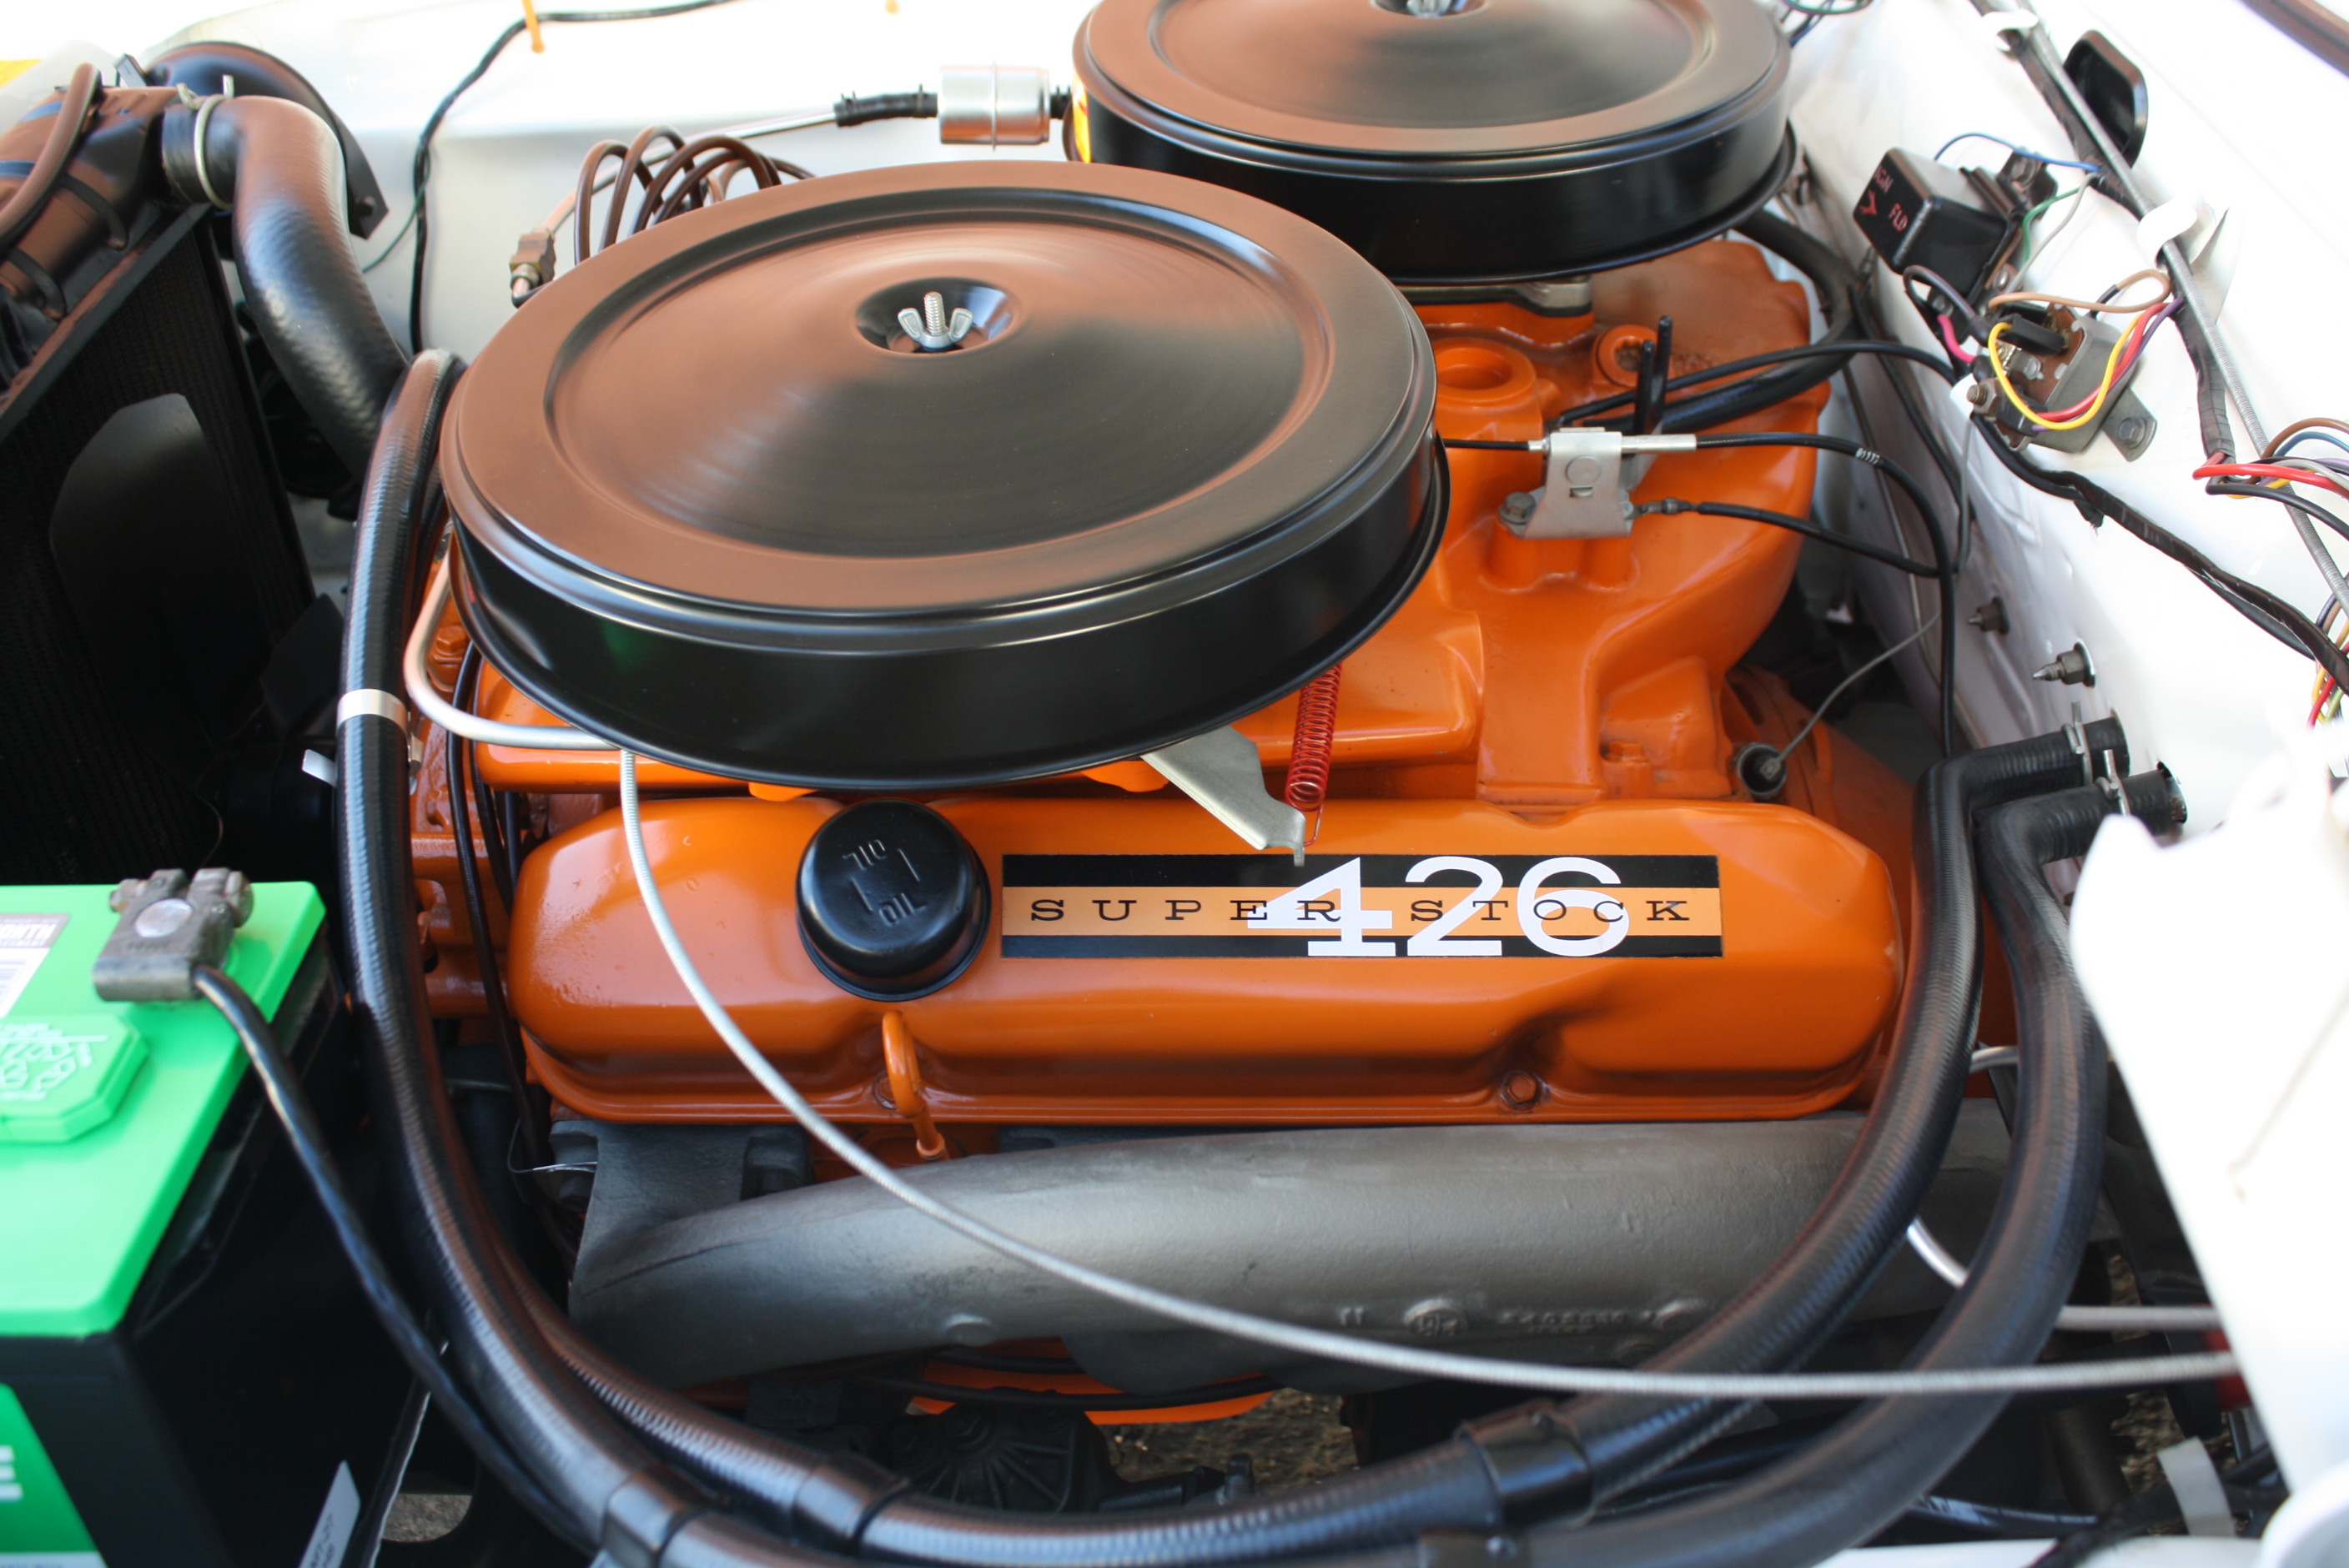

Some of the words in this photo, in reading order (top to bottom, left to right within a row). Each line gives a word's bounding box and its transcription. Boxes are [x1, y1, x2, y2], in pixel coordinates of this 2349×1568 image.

[1889, 204, 1909, 232] FLD
[879, 892, 927, 927] OIL
[1031, 898, 1342, 922] SUPER
[1411, 898, 1688, 922] STOCK
[1247, 857, 1629, 957] 426
[0, 922, 58, 940] ONTH
